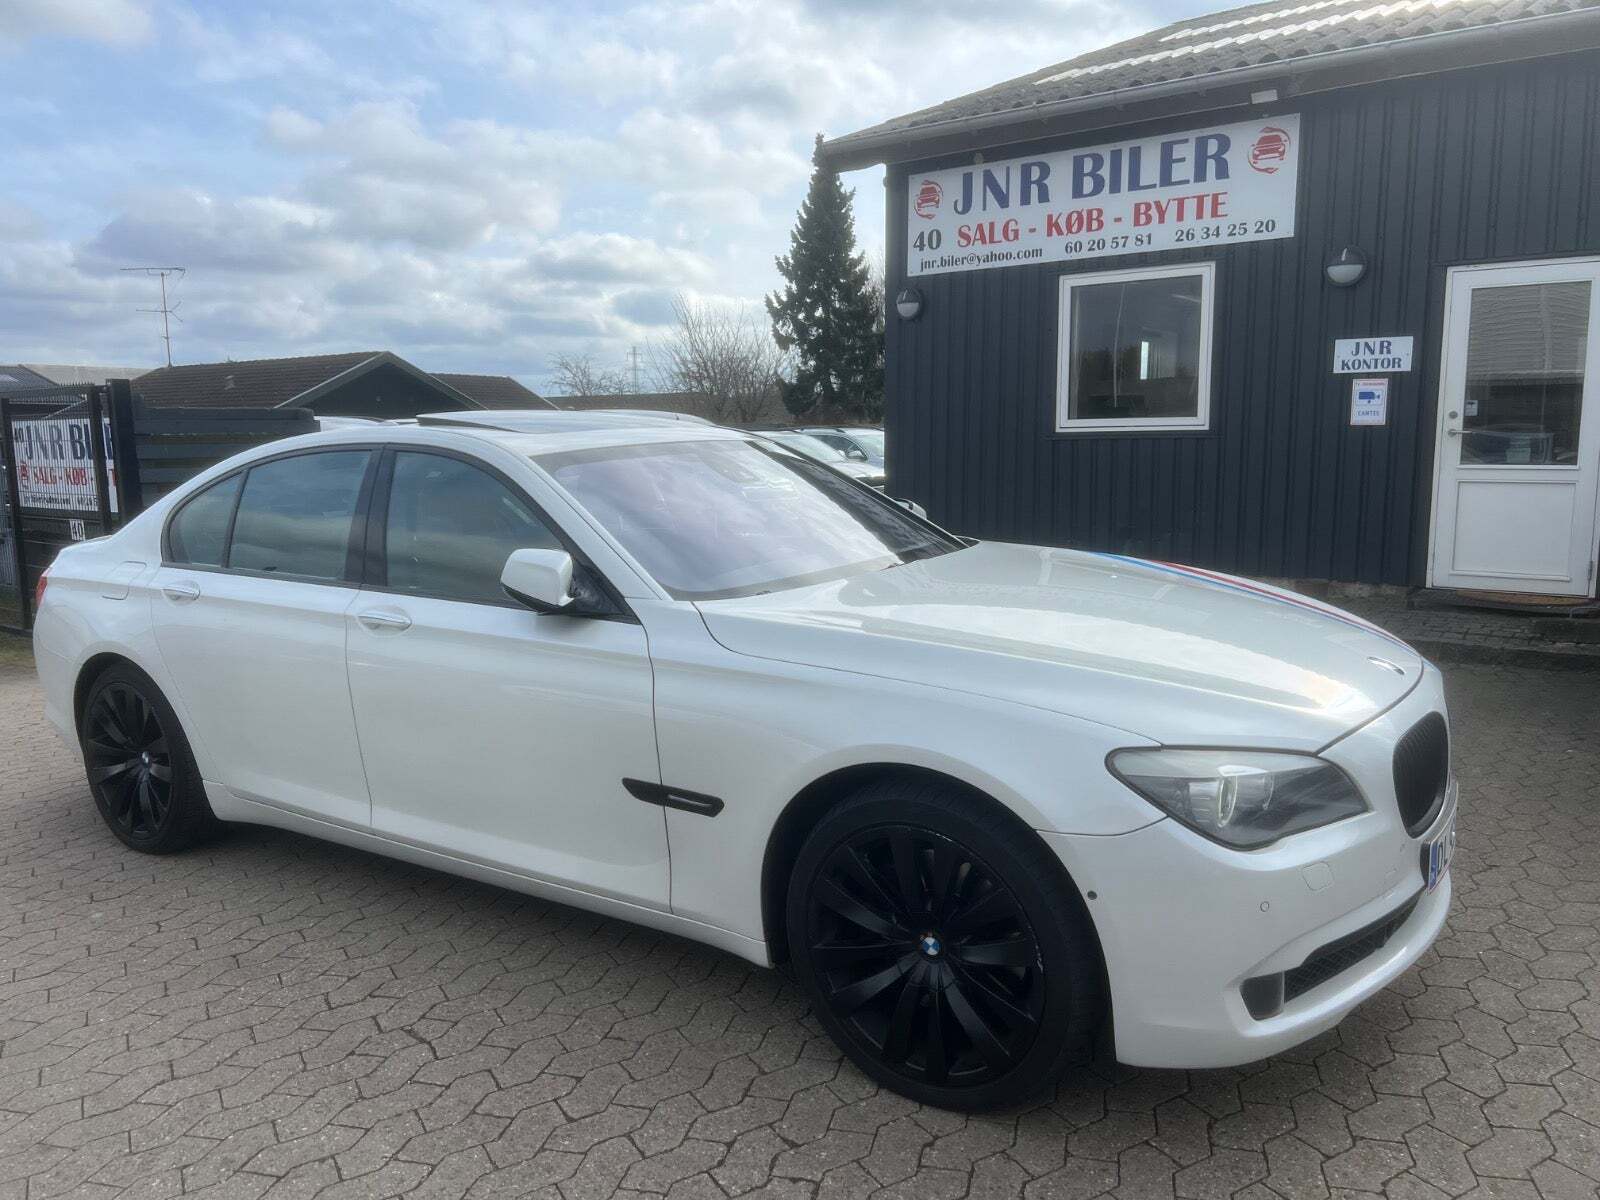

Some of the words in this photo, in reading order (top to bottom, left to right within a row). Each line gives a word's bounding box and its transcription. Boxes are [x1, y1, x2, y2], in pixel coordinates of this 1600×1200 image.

[953, 161, 1050, 215] JNR
[1072, 133, 1231, 199] BILER
[957, 218, 1020, 248] SALG
[1046, 207, 1104, 237] KØB
[1133, 191, 1229, 228] BYTTE
[1175, 228, 1195, 242] 26
[1201, 225, 1221, 239] 34
[1227, 222, 1248, 237] 25
[1254, 219, 1276, 234] 20
[913, 228, 942, 252] 40
[1065, 241, 1083, 254] 60
[1087, 238, 1106, 252] 20
[1111, 235, 1129, 249] 57
[1134, 232, 1152, 246] 81
[920, 248, 1043, 272] jnr.biler@yahoo.com
[1351, 340, 1392, 356] JNR
[1341, 357, 1402, 371] KONTOR
[25, 425, 65, 460] JNR
[33, 466, 57, 485] SALG
